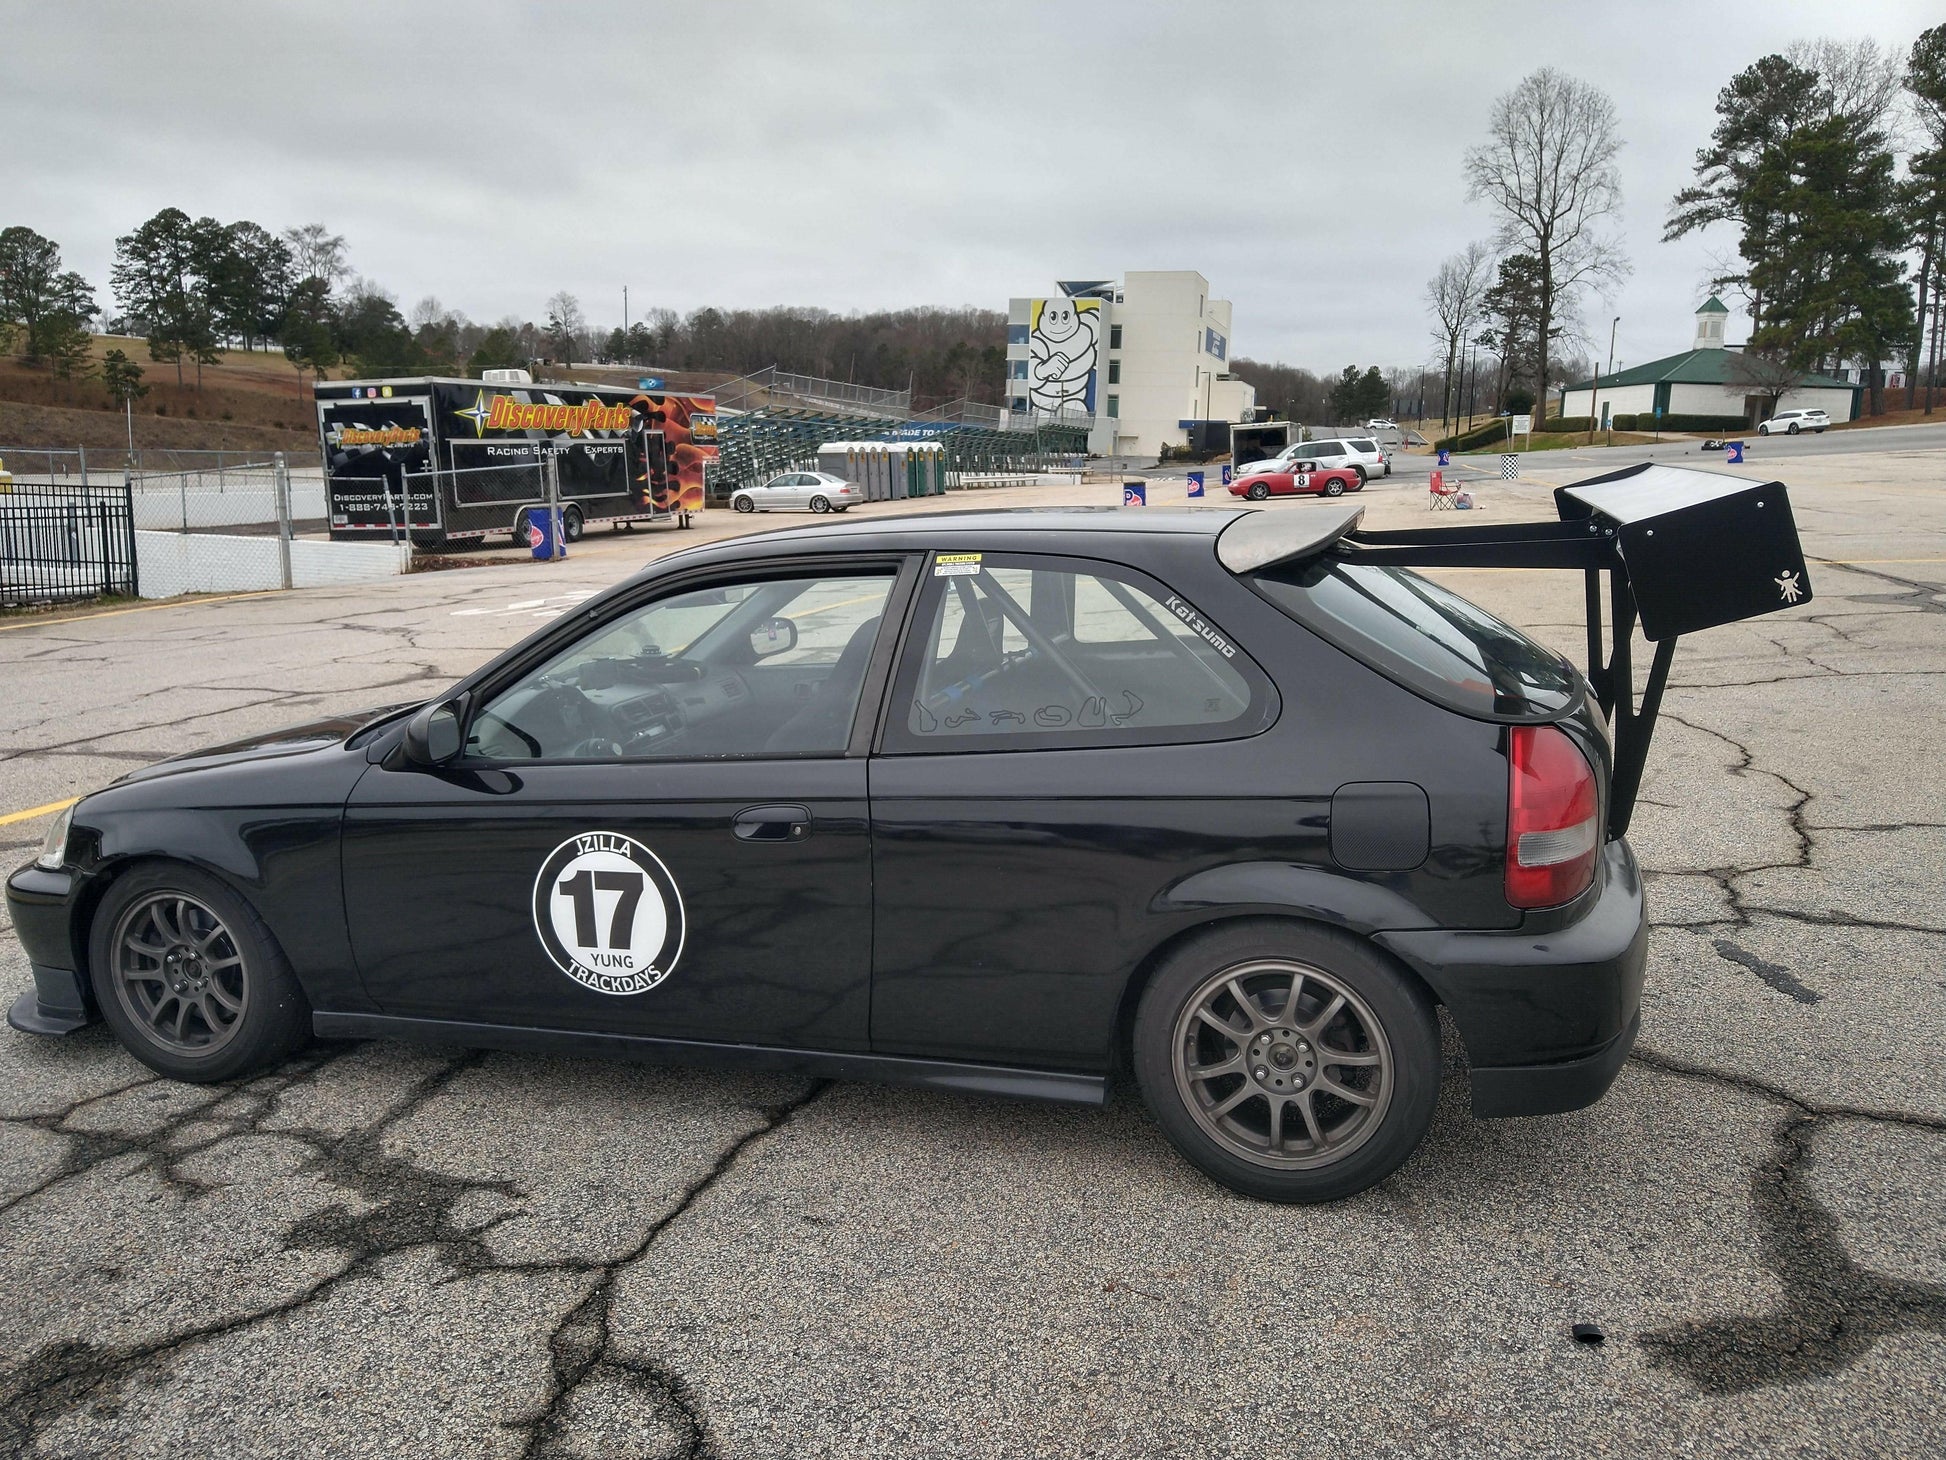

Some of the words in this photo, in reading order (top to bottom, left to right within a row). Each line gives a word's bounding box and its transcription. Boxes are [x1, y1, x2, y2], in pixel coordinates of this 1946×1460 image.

[487, 394, 632, 437] DiscoveryParts
[487, 446, 529, 456] RACING
[584, 445, 624, 455] EXPERTS
[1298, 474, 1306, 486] 8
[1165, 595, 1236, 658] Katsumo
[576, 835, 632, 858] JZILLA
[558, 869, 644, 951] 17
[590, 953, 634, 969] YUNG
[568, 959, 662, 992] TRACKDAYS
